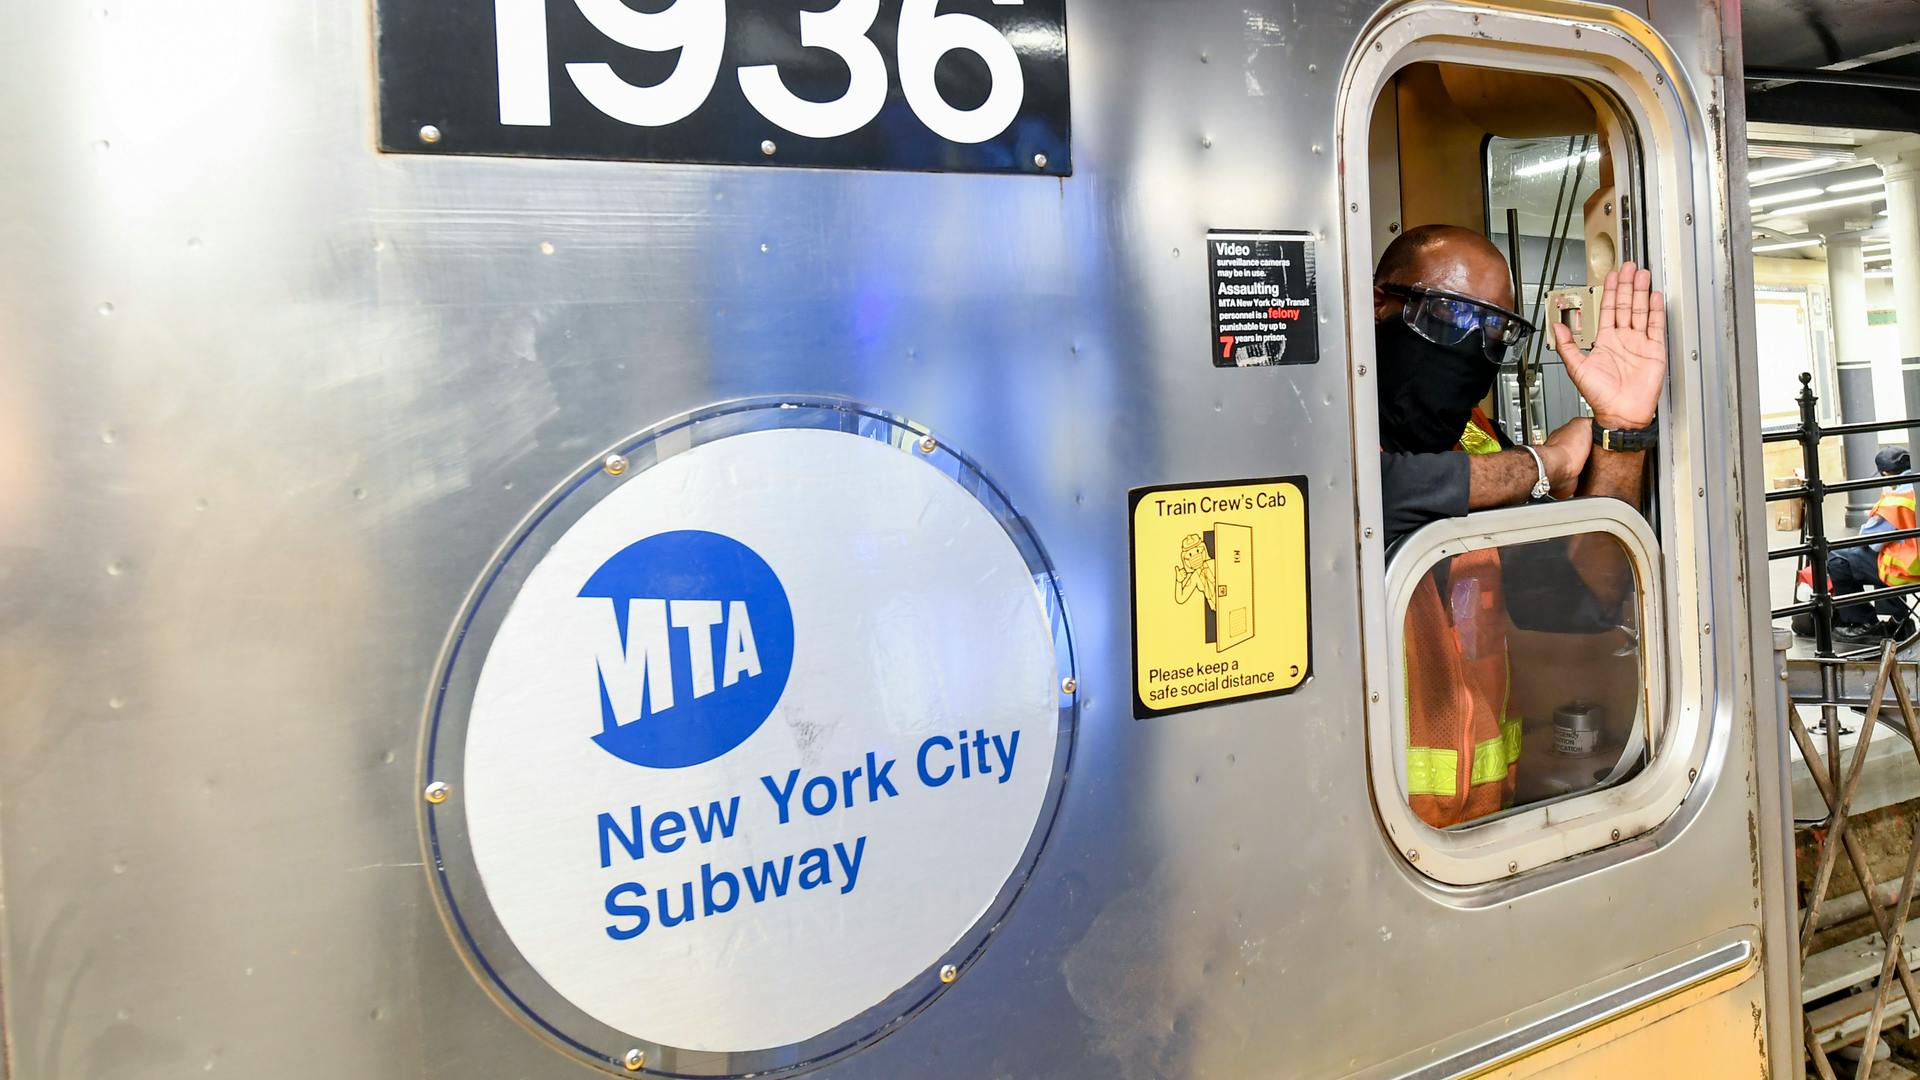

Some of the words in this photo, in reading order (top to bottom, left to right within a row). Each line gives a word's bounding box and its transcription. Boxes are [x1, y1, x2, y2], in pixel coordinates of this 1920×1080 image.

[495, 0, 1025, 144] 1936
[1215, 242, 1250, 256] Video
[1217, 258, 1259, 267] surveillance
[1260, 259, 1290, 267] cameras
[1217, 269, 1233, 278] may
[1233, 268, 1243, 277] be
[1243, 268, 1251, 277] in
[1218, 282, 1279, 297] Assaulting
[1218, 299, 1236, 307] MTA
[1237, 299, 1253, 307] New
[1253, 298, 1270, 307] York
[1271, 298, 1285, 308] City
[1286, 298, 1310, 307] Transit
[1219, 311, 1255, 321] personnel
[1255, 311, 1263, 319] is
[1268, 308, 1300, 321] felony
[1220, 322, 1259, 333] punishable
[1259, 322, 1269, 332] by
[1269, 323, 1279, 331] up
[1279, 322, 1287, 330] to
[1220, 336, 1234, 358] 7
[1235, 334, 1255, 344] years
[1255, 333, 1263, 342] in
[1263, 333, 1287, 343] prison.
[1155, 498, 1197, 516] Train
[1200, 493, 1253, 513] Crew's
[1256, 491, 1286, 509] Cab
[577, 596, 763, 737] MTA
[1149, 667, 1194, 684] Please
[1196, 662, 1229, 676] keep
[1231, 660, 1239, 671] a
[1149, 684, 1178, 701] safe
[1180, 677, 1219, 696] social
[1221, 671, 1275, 690] distance
[597, 795, 741, 869] New
[760, 751, 900, 826] York
[916, 728, 1021, 789] City
[604, 836, 867, 941] Subway
